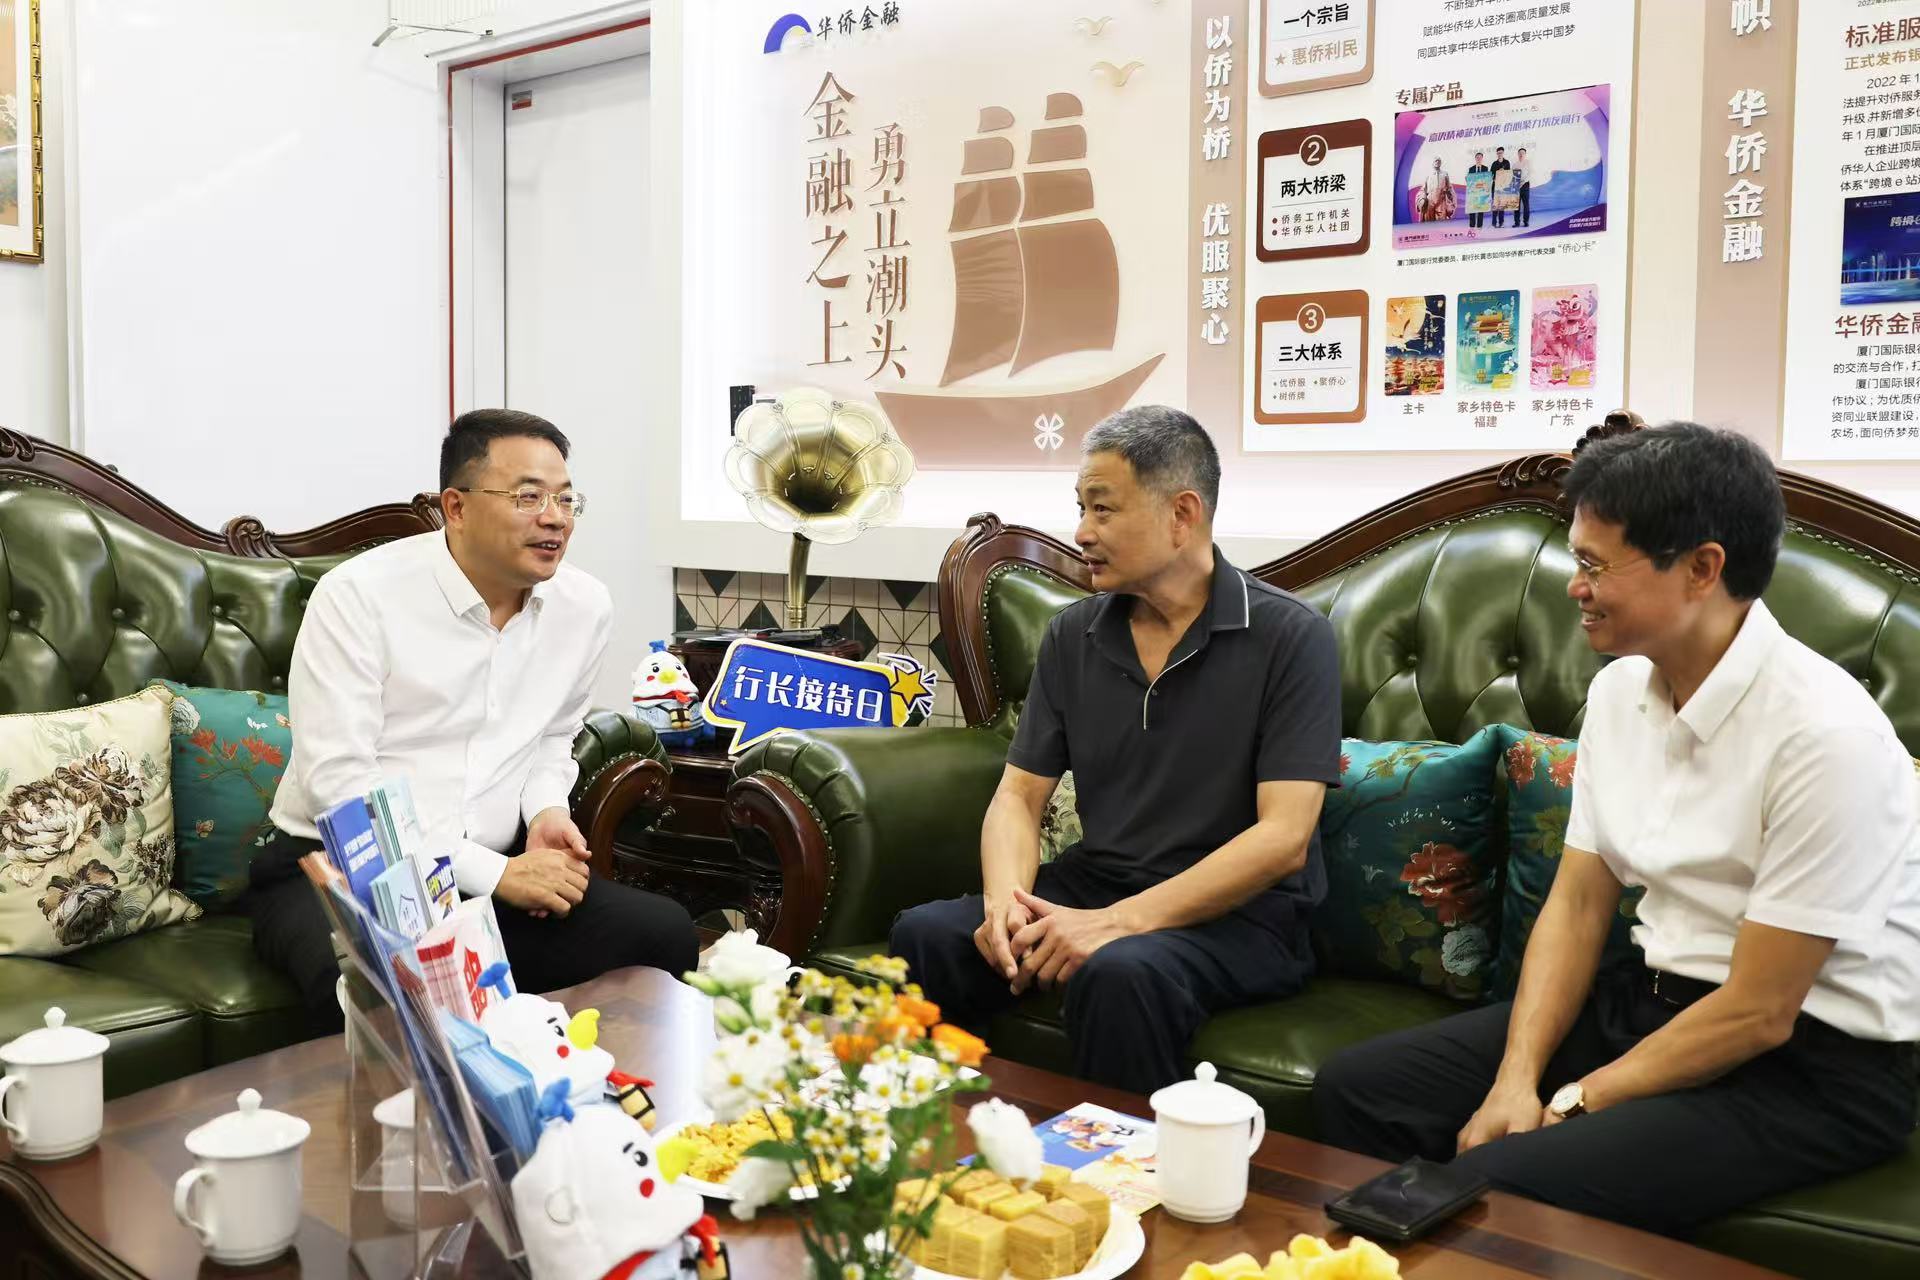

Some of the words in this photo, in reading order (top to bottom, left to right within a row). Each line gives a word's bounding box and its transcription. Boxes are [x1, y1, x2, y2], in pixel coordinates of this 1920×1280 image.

[817, 1, 900, 40] 华侨金融
[1283, 3, 1349, 27] 一个宗旨
[1423, 2, 1571, 38] 赋能华侨华人经济圈高质量发展
[1417, 24, 1576, 59] 同圆共享中华民族伟大复兴中国梦
[1845, 17, 1920, 48] 标准服
[1291, 38, 1358, 65] 惠侨利民
[1202, 15, 1233, 161] 以侨为桥
[1396, 81, 1464, 106] 专属产品
[1866, 76, 1897, 89] 2022
[1899, 74, 1912, 84] 年
[1307, 141, 1320, 162] 2
[1281, 174, 1346, 198] 两大桥梁
[1723, 88, 1769, 263] 华侨金融
[1906, 174, 1920, 186] 站
[802, 71, 856, 367] 金融之上
[1282, 208, 1350, 225] 侨务工作机关
[1282, 221, 1350, 237] 华侨华人社团
[864, 122, 912, 381] 勇立潮头
[1201, 202, 1231, 345] 优服聚心
[1305, 309, 1318, 330] 3
[1279, 342, 1342, 361] 三大体系
[1402, 402, 1425, 415] 主卡
[1457, 400, 1517, 414] 家乡特色卡
[1531, 398, 1594, 412] 家乡特色卡
[1474, 415, 1498, 428] 福建
[1550, 413, 1575, 426] 广东
[734, 665, 884, 723] 行长接待日
